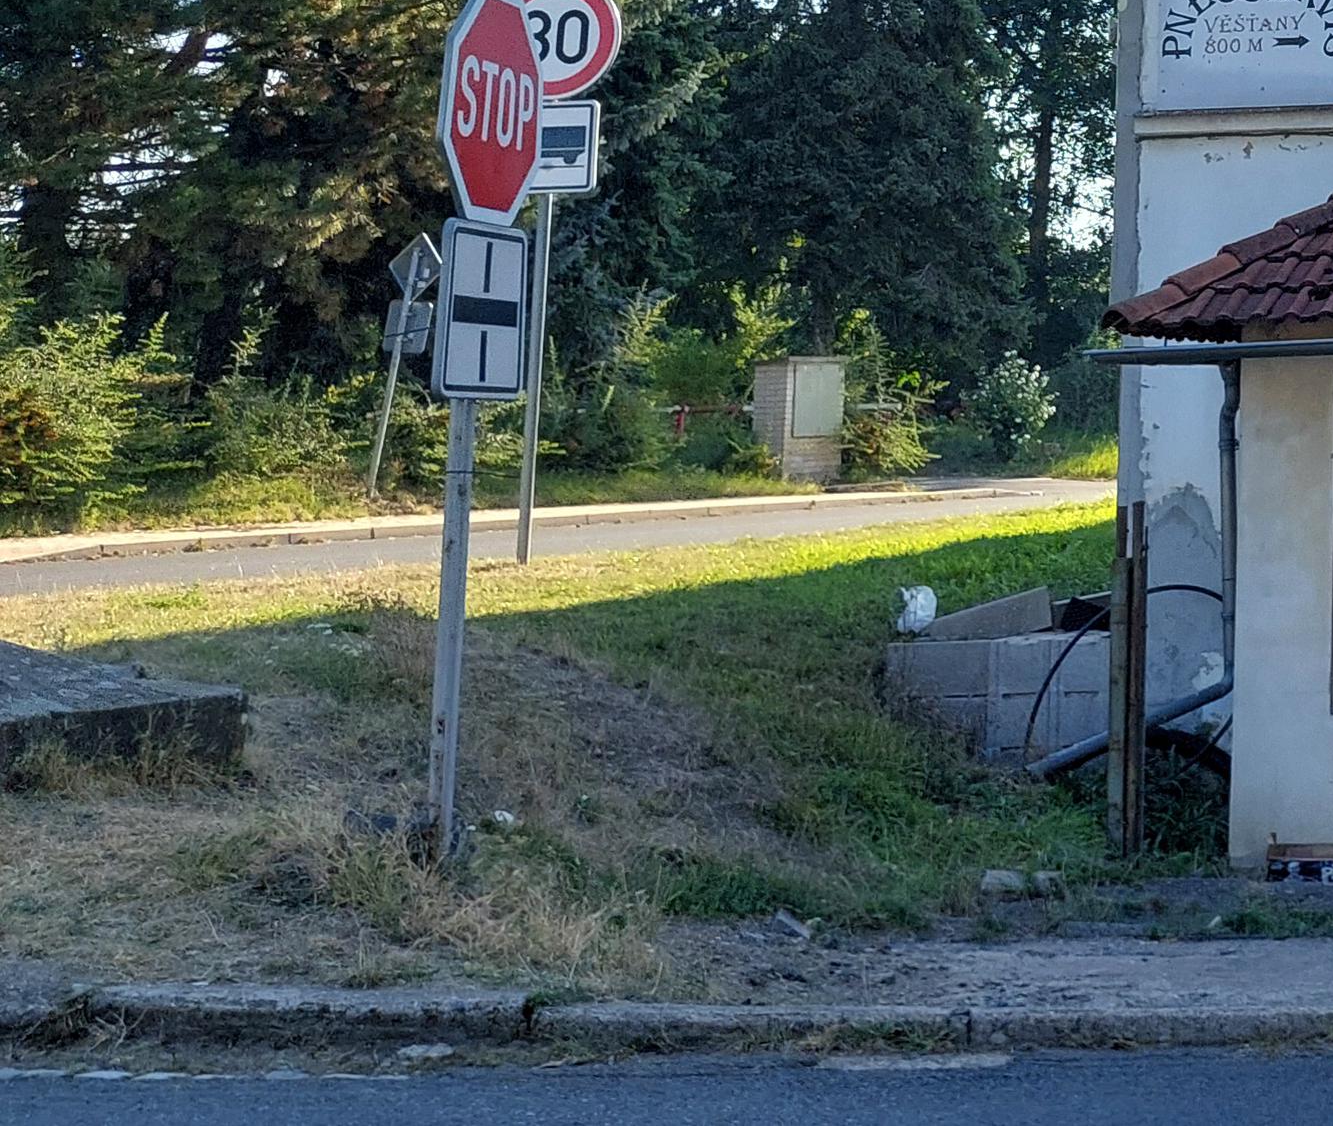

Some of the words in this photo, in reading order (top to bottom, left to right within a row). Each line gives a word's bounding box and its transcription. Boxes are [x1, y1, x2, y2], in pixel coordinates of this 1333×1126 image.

[527, 9, 590, 65] 30
[1203, 11, 1306, 33] VĚŠŤANY
[1204, 35, 1241, 54] 800
[1247, 37, 1263, 53] M
[456, 54, 536, 152] STOP
